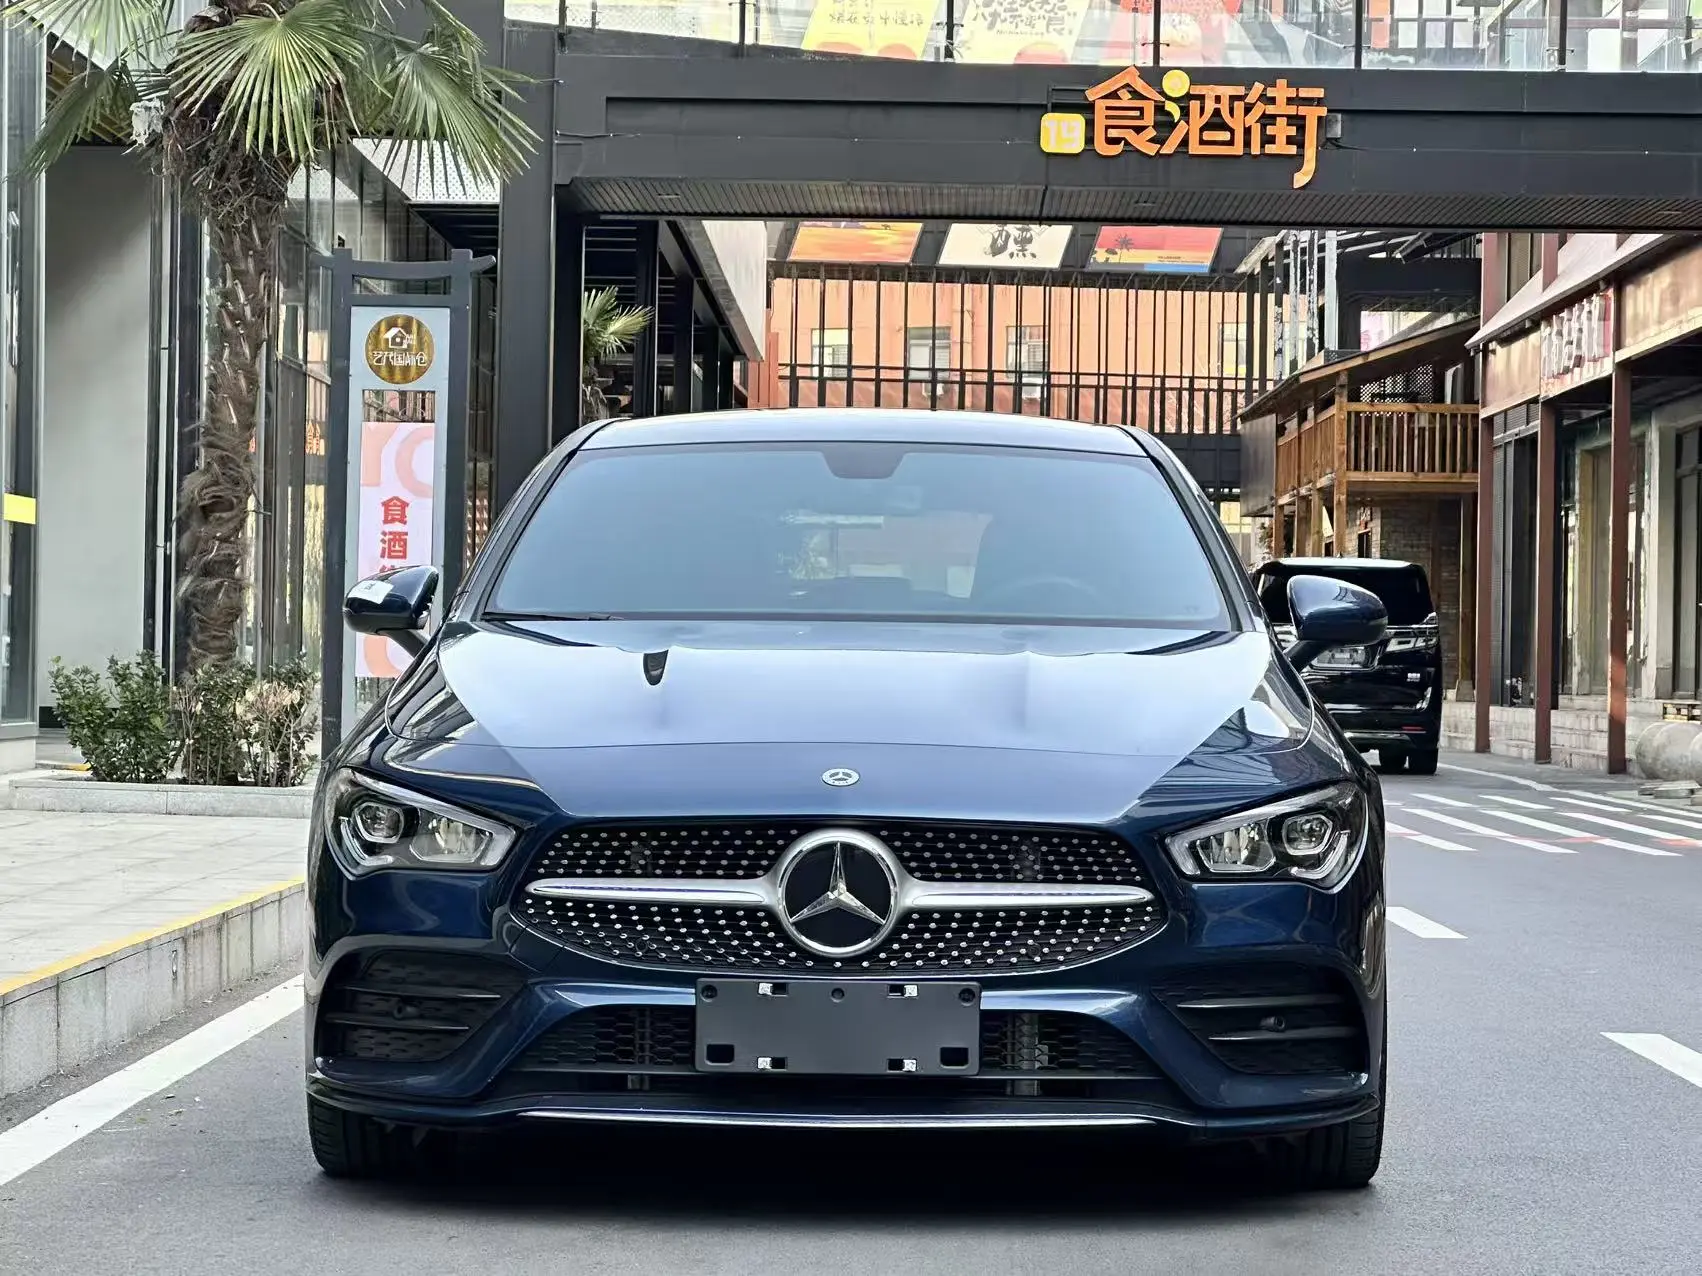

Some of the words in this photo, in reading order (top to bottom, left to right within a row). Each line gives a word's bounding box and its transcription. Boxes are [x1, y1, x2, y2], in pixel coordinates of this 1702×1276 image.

[1043, 120, 1081, 149] 19
[1085, 66, 1327, 189] 食酒街
[380, 495, 410, 573] 食酒
